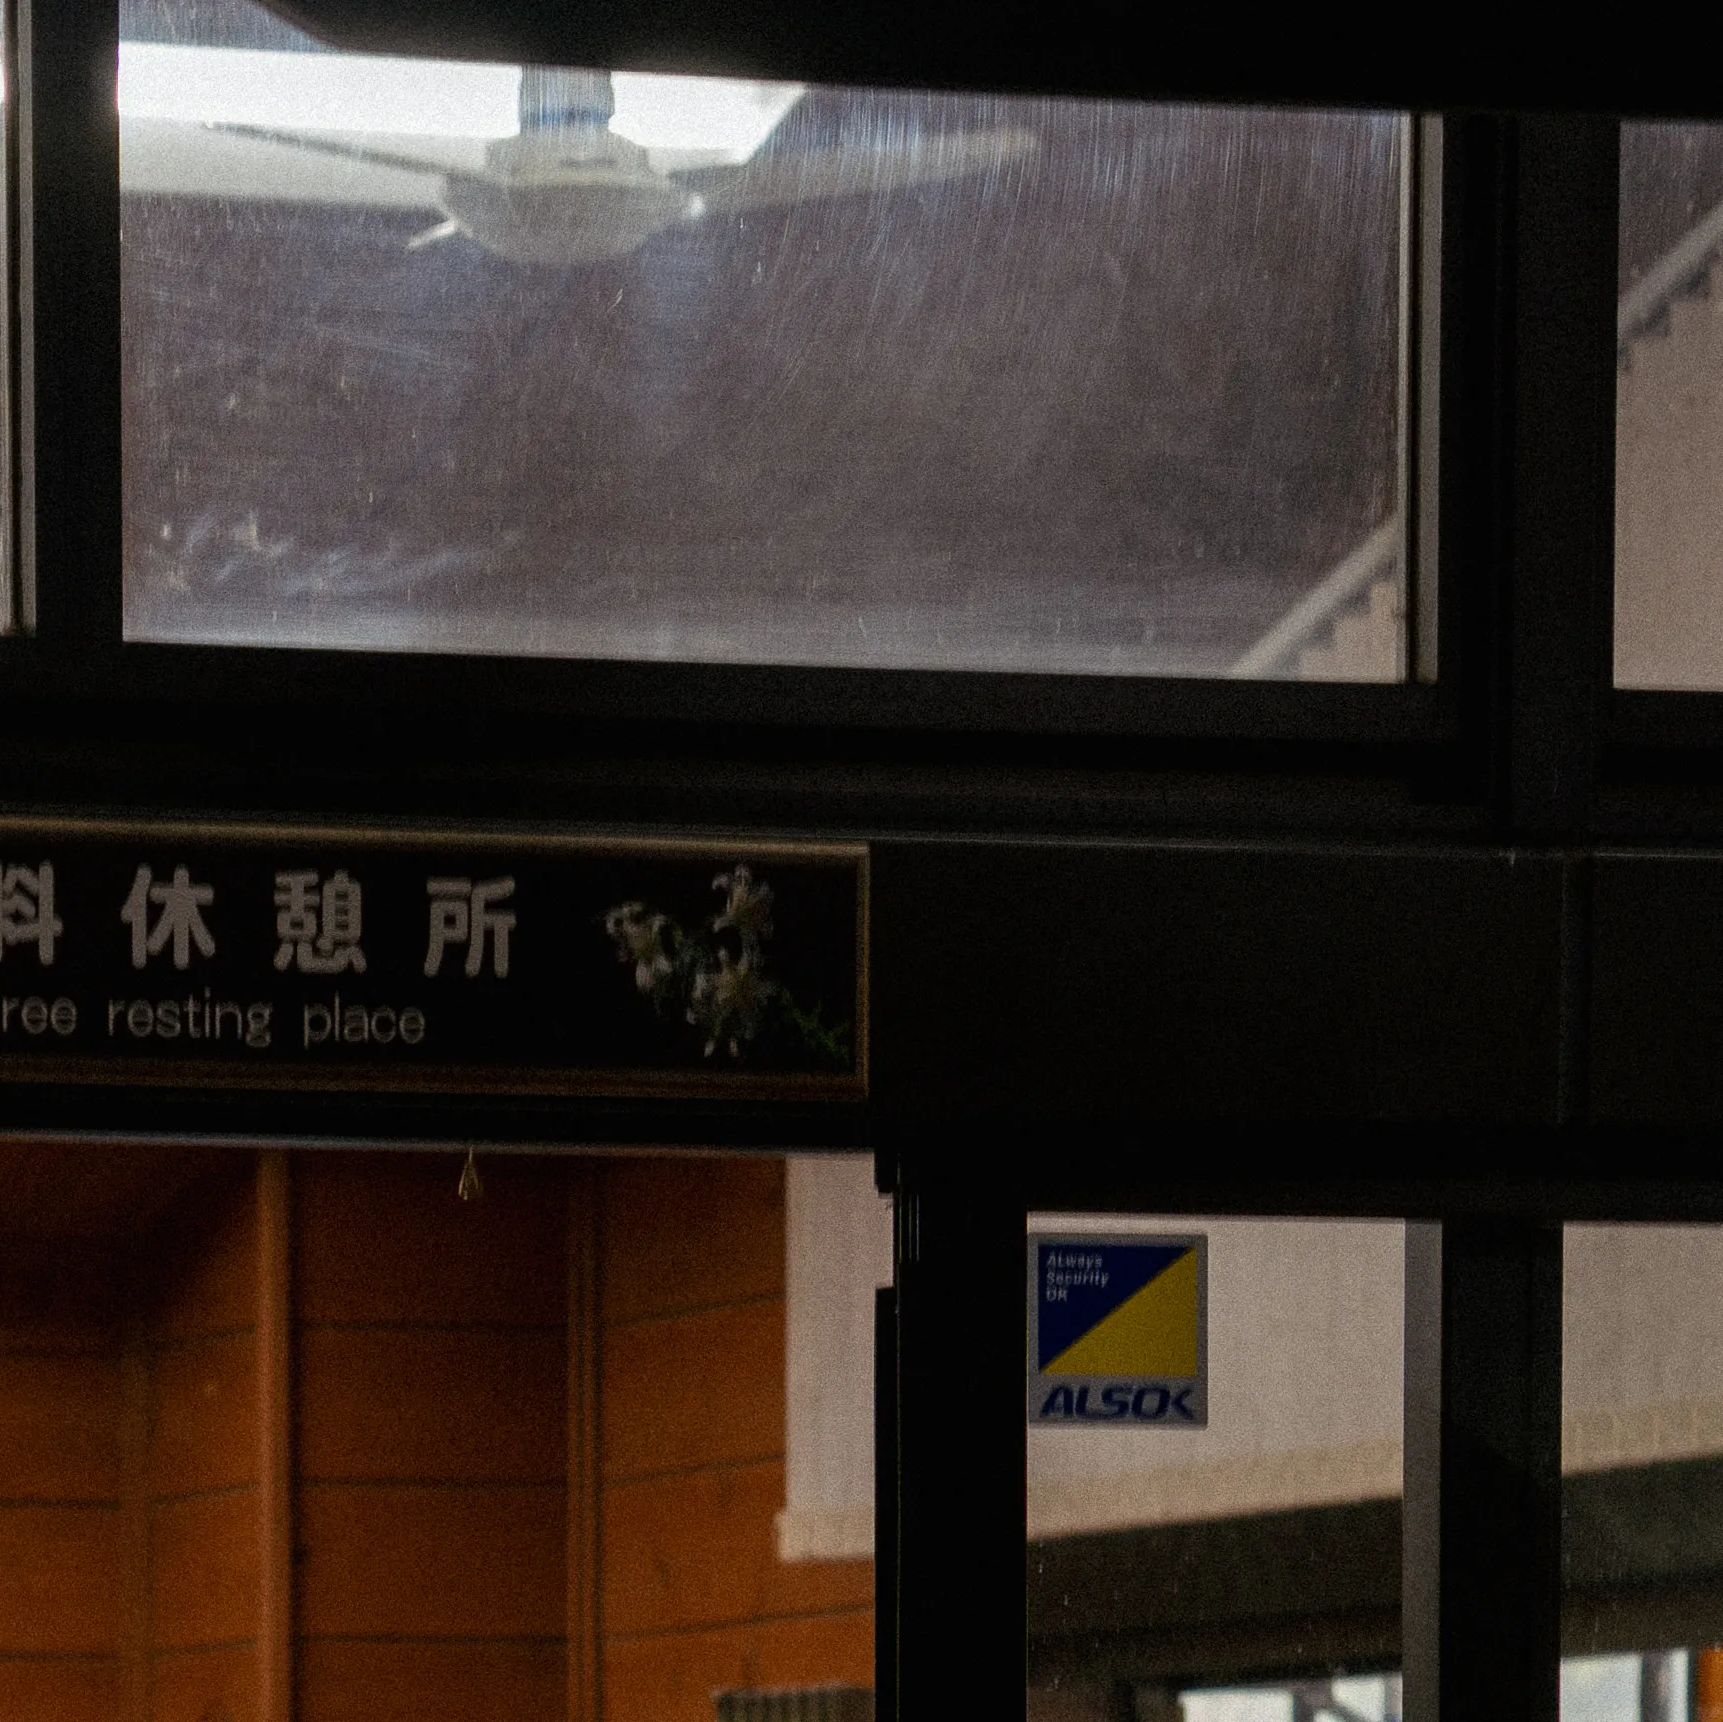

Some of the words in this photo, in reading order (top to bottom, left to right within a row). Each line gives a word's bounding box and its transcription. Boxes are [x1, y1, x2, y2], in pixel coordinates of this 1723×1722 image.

[106, 985, 274, 1049] resting
[302, 991, 427, 1051] place
[1045, 1269, 1110, 1288] Security
[1039, 1382, 1195, 1421] ALSOK
